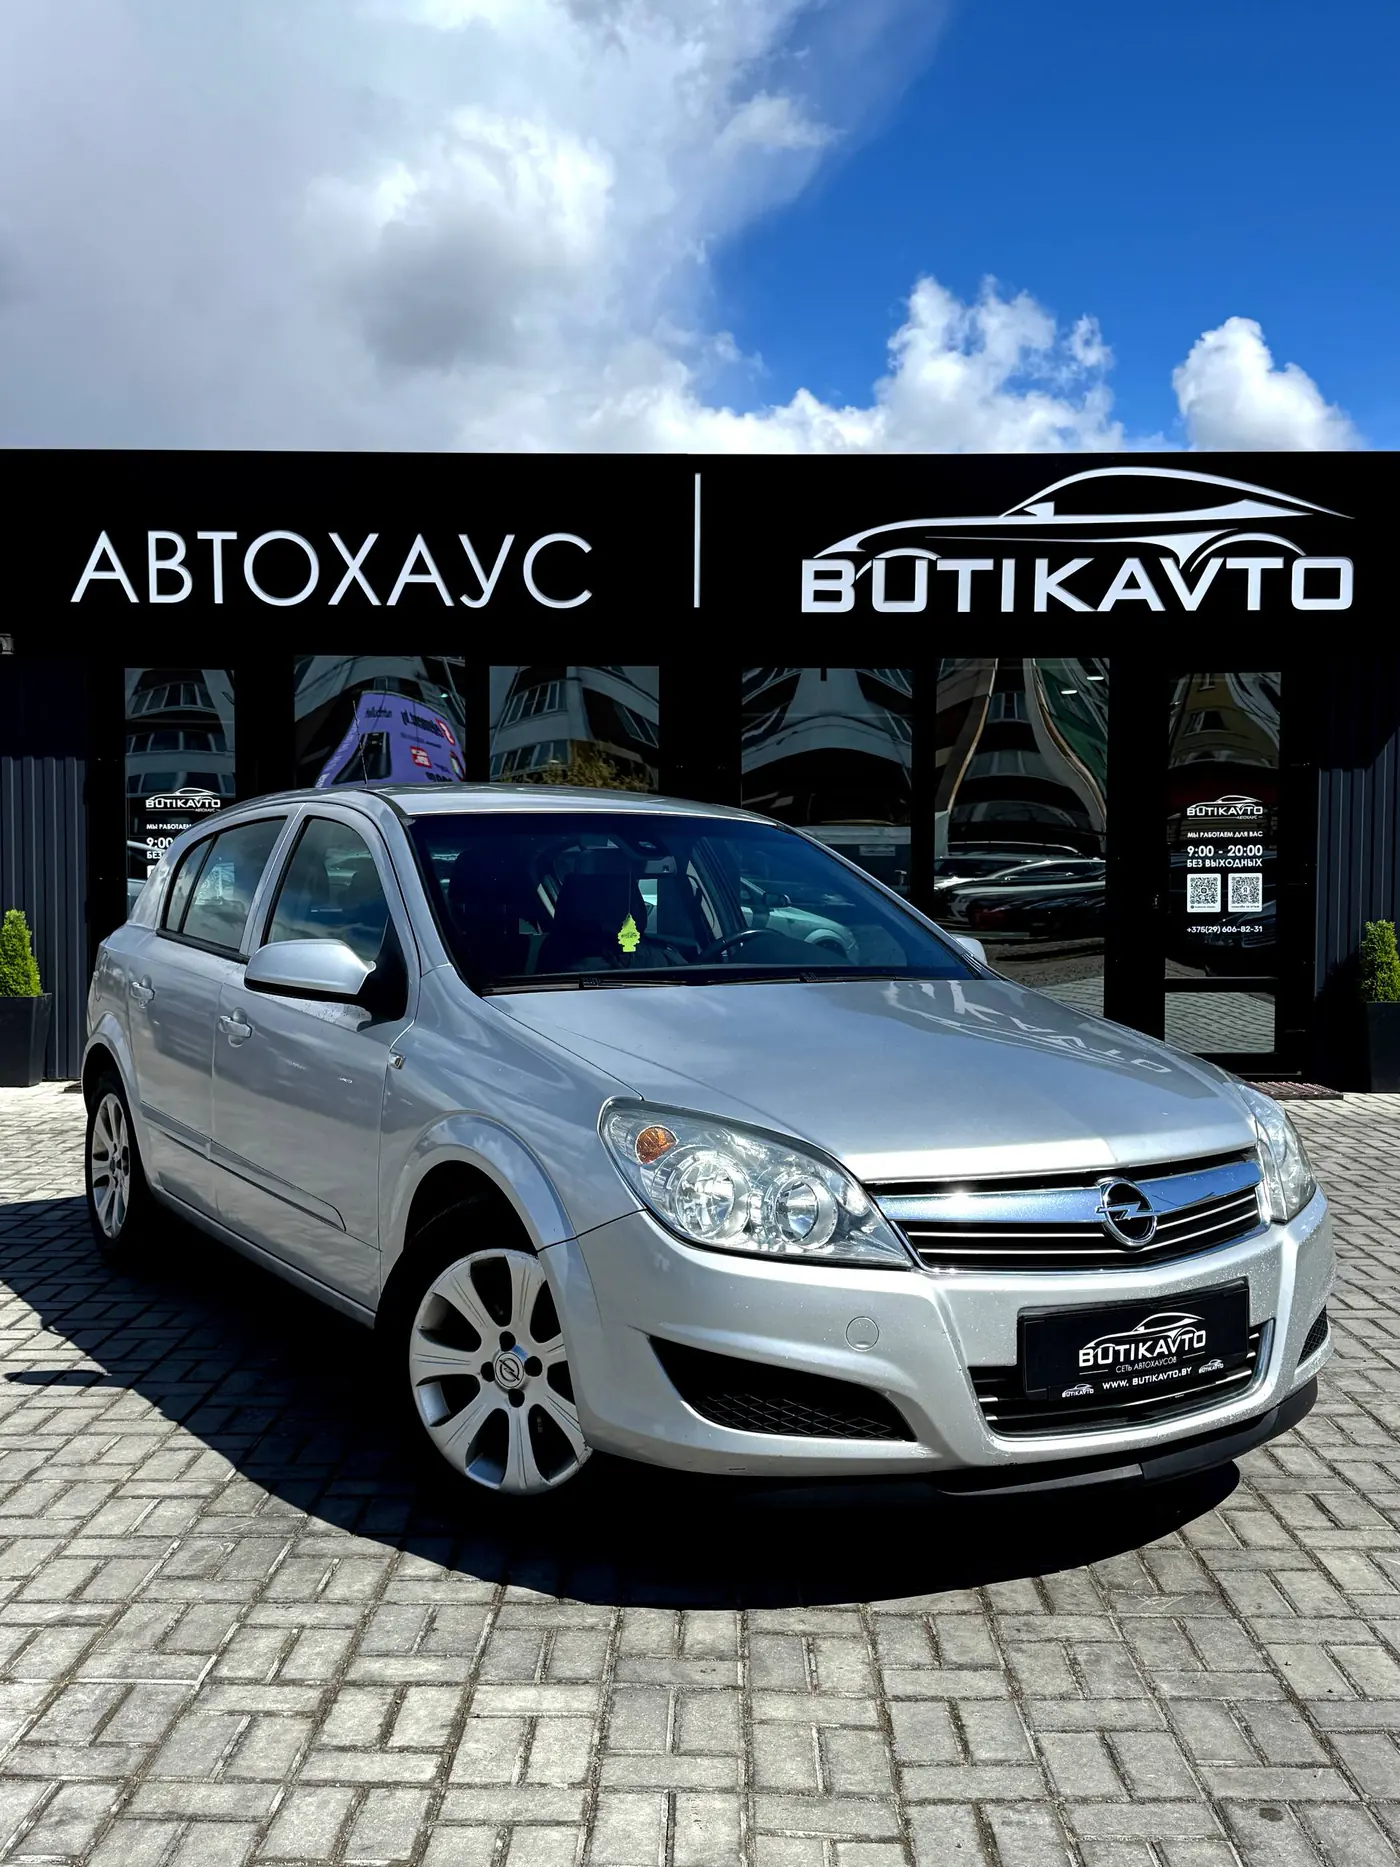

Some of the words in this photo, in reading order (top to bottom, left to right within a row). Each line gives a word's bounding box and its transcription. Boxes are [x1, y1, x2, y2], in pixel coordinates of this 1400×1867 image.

[70, 529, 593, 609] АВТОХАУС
[801, 555, 1355, 614] BUTIKAVTO
[145, 799, 221, 808] BUTIKAVTO
[1186, 806, 1263, 816] BUTIKAVTO
[146, 850, 163, 859] БЕЗ
[1187, 845, 1215, 857] 9:00
[1227, 844, 1263, 857] 20:00
[1187, 859, 1203, 868] БЕЗ
[1205, 858, 1263, 868] ВЫХОДНЫХ
[1186, 925, 1221, 934] +375(29)
[1079, 1330, 1206, 1367] BUTIKAVTO
[1115, 1364, 1133, 1374] СЕТЬ
[1134, 1357, 1177, 1371] АВТОХАУСОВ
[1102, 1379, 1129, 1390] WWW.
[1132, 1367, 1192, 1386] BUTIKAVTO.BY
